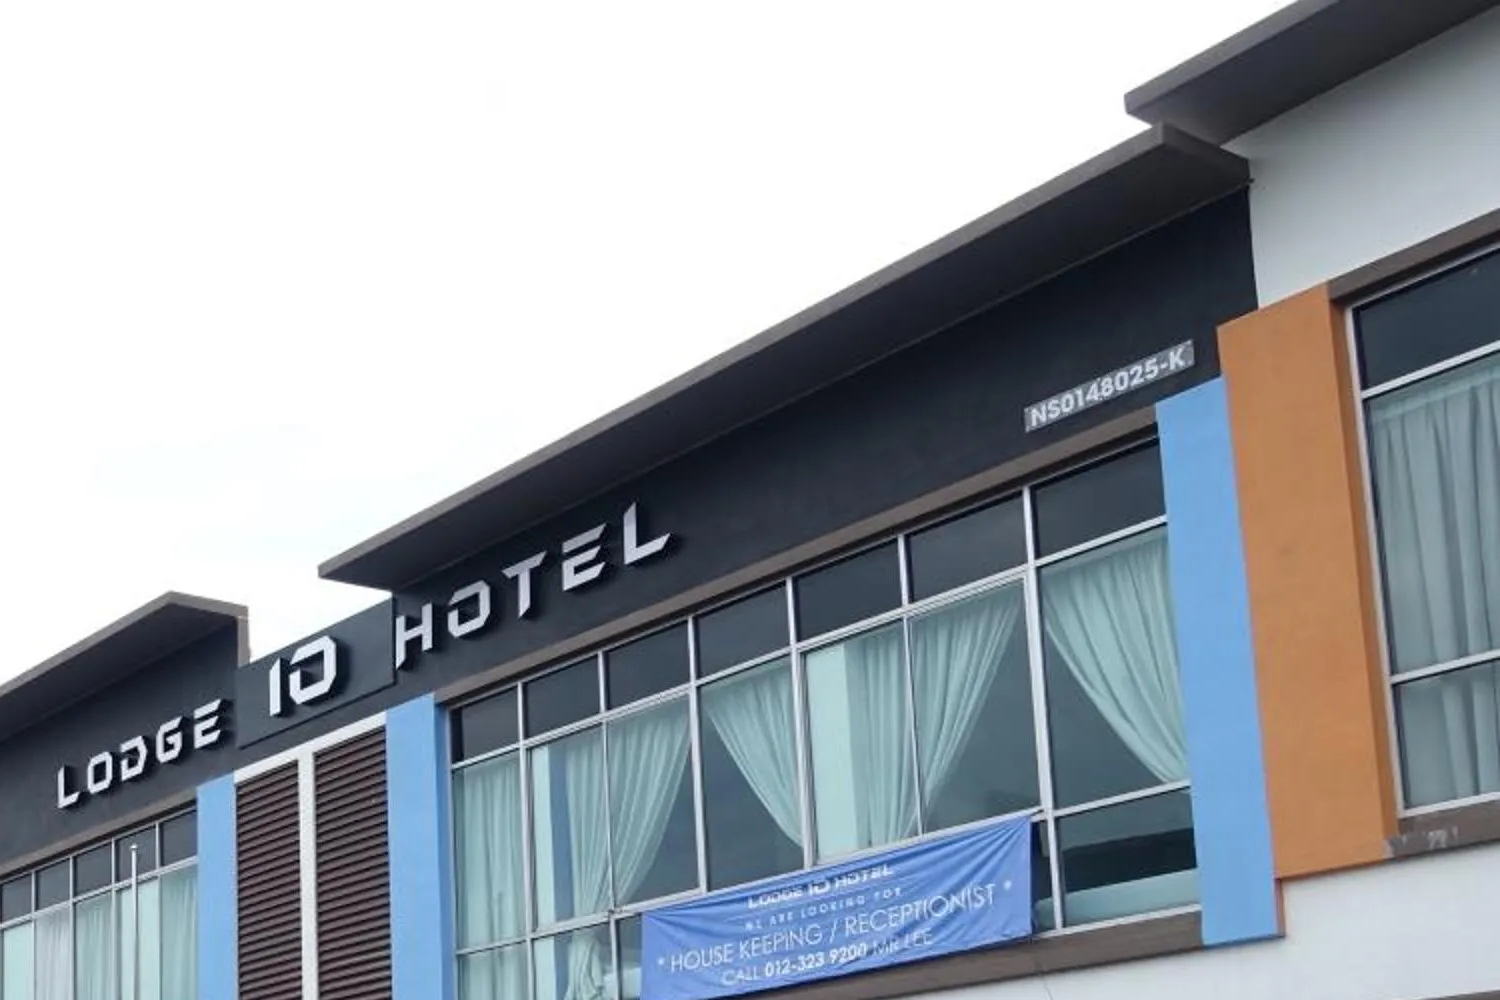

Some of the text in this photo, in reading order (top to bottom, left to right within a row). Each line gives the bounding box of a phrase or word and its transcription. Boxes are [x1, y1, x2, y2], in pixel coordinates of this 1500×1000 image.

[1030, 348, 1186, 427] NS0148025-K
[57, 698, 222, 810] LODGE
[395, 501, 671, 670] HOTEL
[835, 864, 894, 889] HOTEL
[670, 943, 734, 974] HOUSE
[739, 924, 823, 960] KEEPING
[844, 883, 997, 938] RECEPTIONIST
[770, 911, 794, 926] ARE
[801, 895, 866, 919] LOOKING
[720, 967, 761, 987] CALL
[764, 952, 826, 977] 012-323
